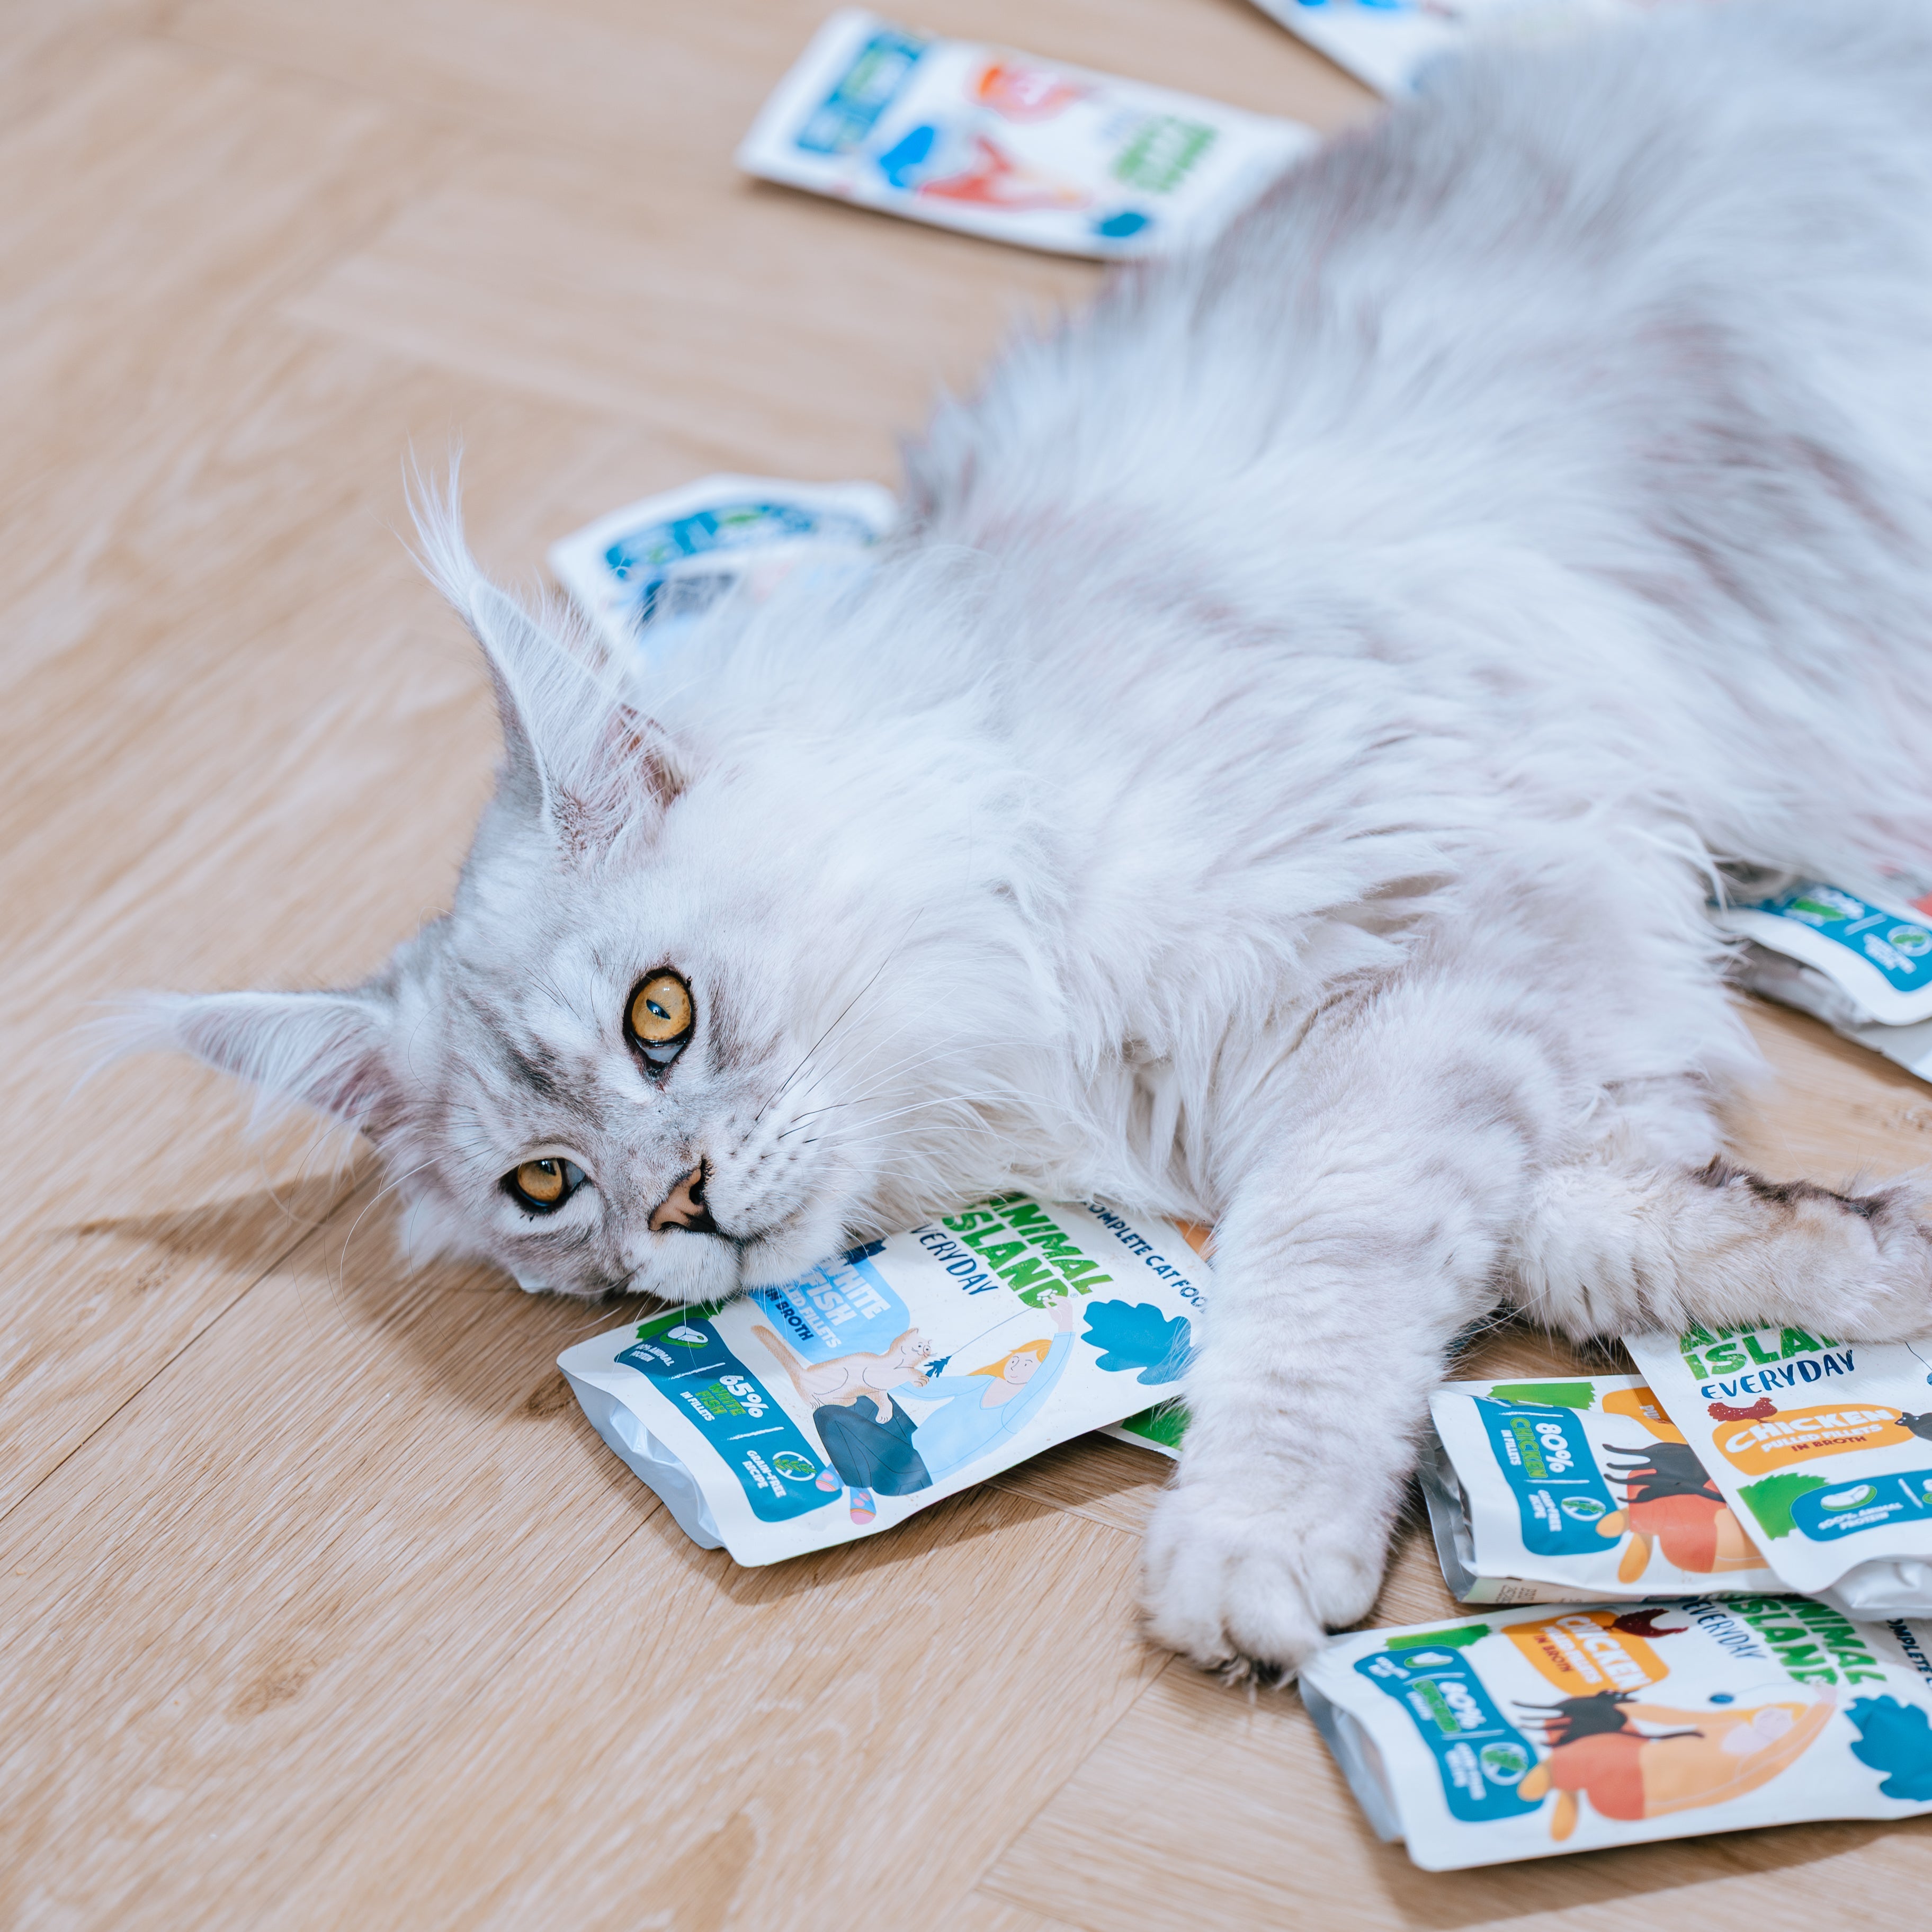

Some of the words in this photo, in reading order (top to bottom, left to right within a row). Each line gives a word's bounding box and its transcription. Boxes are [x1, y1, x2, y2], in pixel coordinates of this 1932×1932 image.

[909, 1222, 999, 1295] VERYDAY
[942, 1210, 1069, 1309] SLAND
[989, 1194, 1114, 1295] NIMAL
[1082, 1200, 1153, 1256] OMPLETE
[1146, 1255, 1182, 1280] CAT
[1170, 1278, 1209, 1314] FOO
[775, 1301, 815, 1341] BROTH
[800, 1272, 858, 1327] FISH
[798, 1306, 842, 1348] FILLETS
[1683, 1324, 1840, 1381] ISLA
[1701, 1349, 1855, 1399] EVERYDAY
[679, 1391, 693, 1402] IN
[687, 1397, 715, 1421] FILLETS
[695, 1390, 728, 1415] FISH
[708, 1382, 747, 1416] WHITE
[719, 1375, 770, 1418] 65%
[1510, 1417, 1549, 1478] CHICKEN
[1535, 1423, 1575, 1473] 80%
[1725, 1409, 1895, 1454] CHICKEN
[1760, 1433, 1820, 1453] PULLED
[1820, 1424, 1883, 1441] FILLETS
[1790, 1443, 1810, 1452] IN
[1812, 1435, 1867, 1448] BROTH
[742, 1460, 769, 1489] RECIPE
[746, 1450, 787, 1498] GRAIN-FREE
[1556, 1615, 1653, 1689] CHICKEN
[1681, 1599, 1768, 1659] EVERYDAY
[1727, 1598, 1839, 1686] SLAND
[1781, 1596, 1888, 1685] NIMAL
